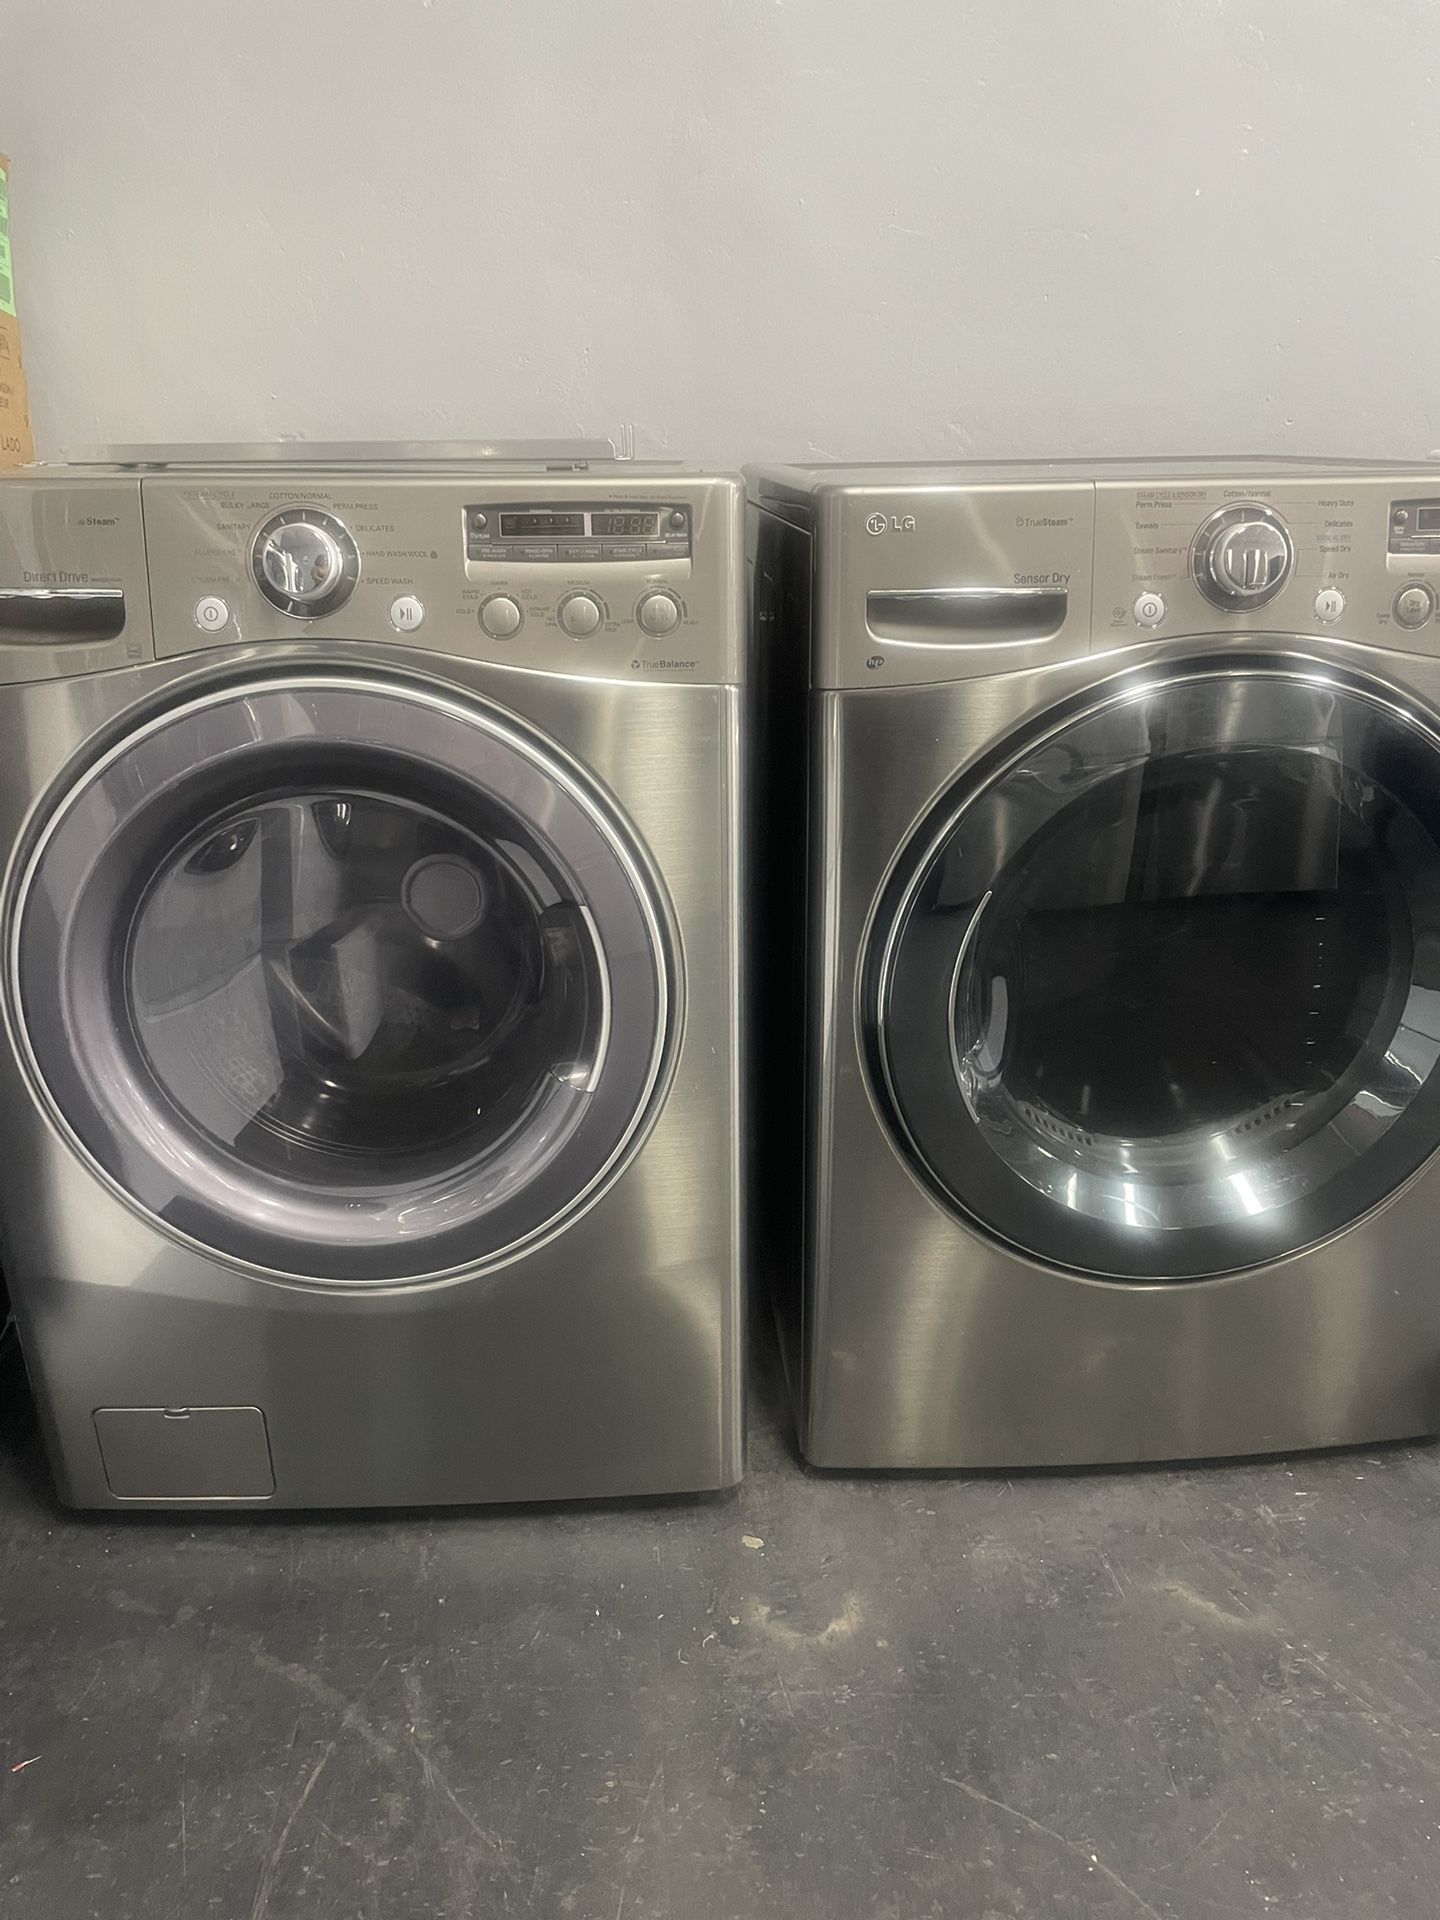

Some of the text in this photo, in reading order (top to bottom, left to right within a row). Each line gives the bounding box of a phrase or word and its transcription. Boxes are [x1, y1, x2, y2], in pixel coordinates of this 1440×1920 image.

[1223, 489, 1272, 498] Cotton/Normal
[355, 503, 378, 511] PRESS
[1135, 501, 1172, 509] Perm Press
[1318, 499, 1355, 508] Heavy Duty
[890, 515, 916, 533] LG
[1324, 520, 1354, 528] Delicates
[1338, 546, 1352, 554] Dry
[23, 571, 57, 583] Direct
[59, 571, 89, 583] Drive
[1013, 572, 1071, 585] Sensor Dry
[1338, 572, 1350, 580] Dry
[366, 577, 413, 585] SPEED WASH
